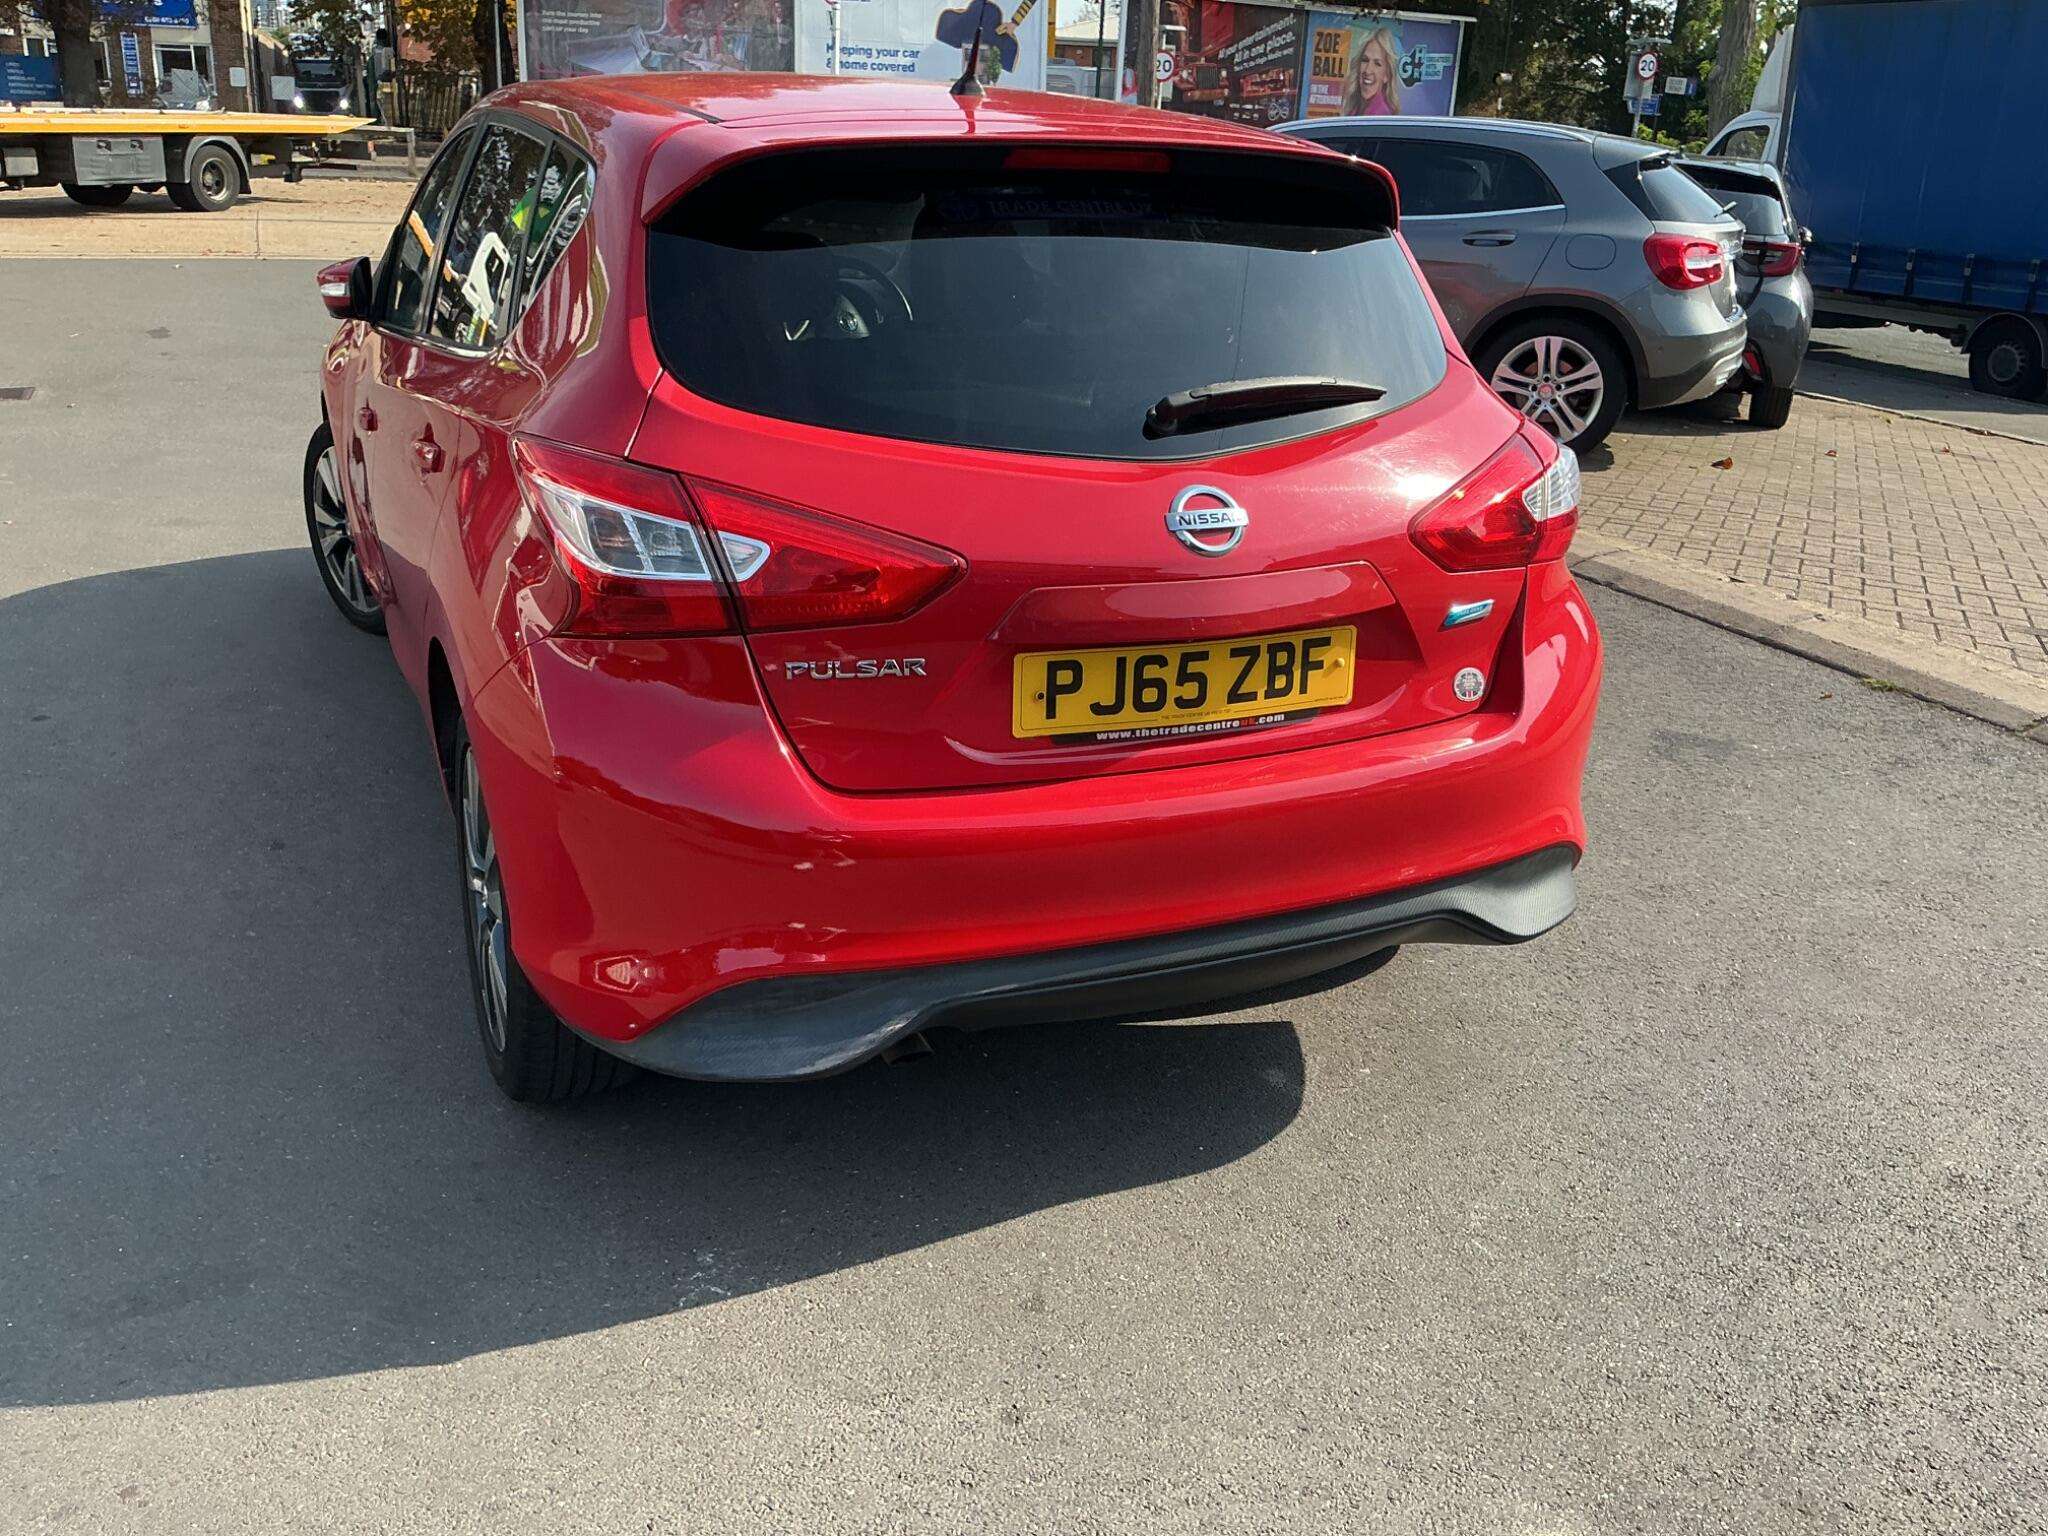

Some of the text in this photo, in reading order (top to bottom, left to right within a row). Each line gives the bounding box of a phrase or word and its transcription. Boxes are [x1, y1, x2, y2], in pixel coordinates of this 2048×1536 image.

[826, 43, 921, 59] Keping your car
[1266, 31, 1296, 54] place.
[1314, 31, 1341, 54] ZOE
[870, 61, 915, 73] covered
[1312, 55, 1345, 78] BALL
[1640, 59, 1655, 72] 20
[986, 199, 1049, 214] TRADE
[1179, 512, 1240, 527] NISSA
[784, 657, 927, 680] PULSAR
[1045, 636, 1332, 720] PJ65 ZBF
[1096, 712, 1286, 741] www.thetradecentreuk.com
